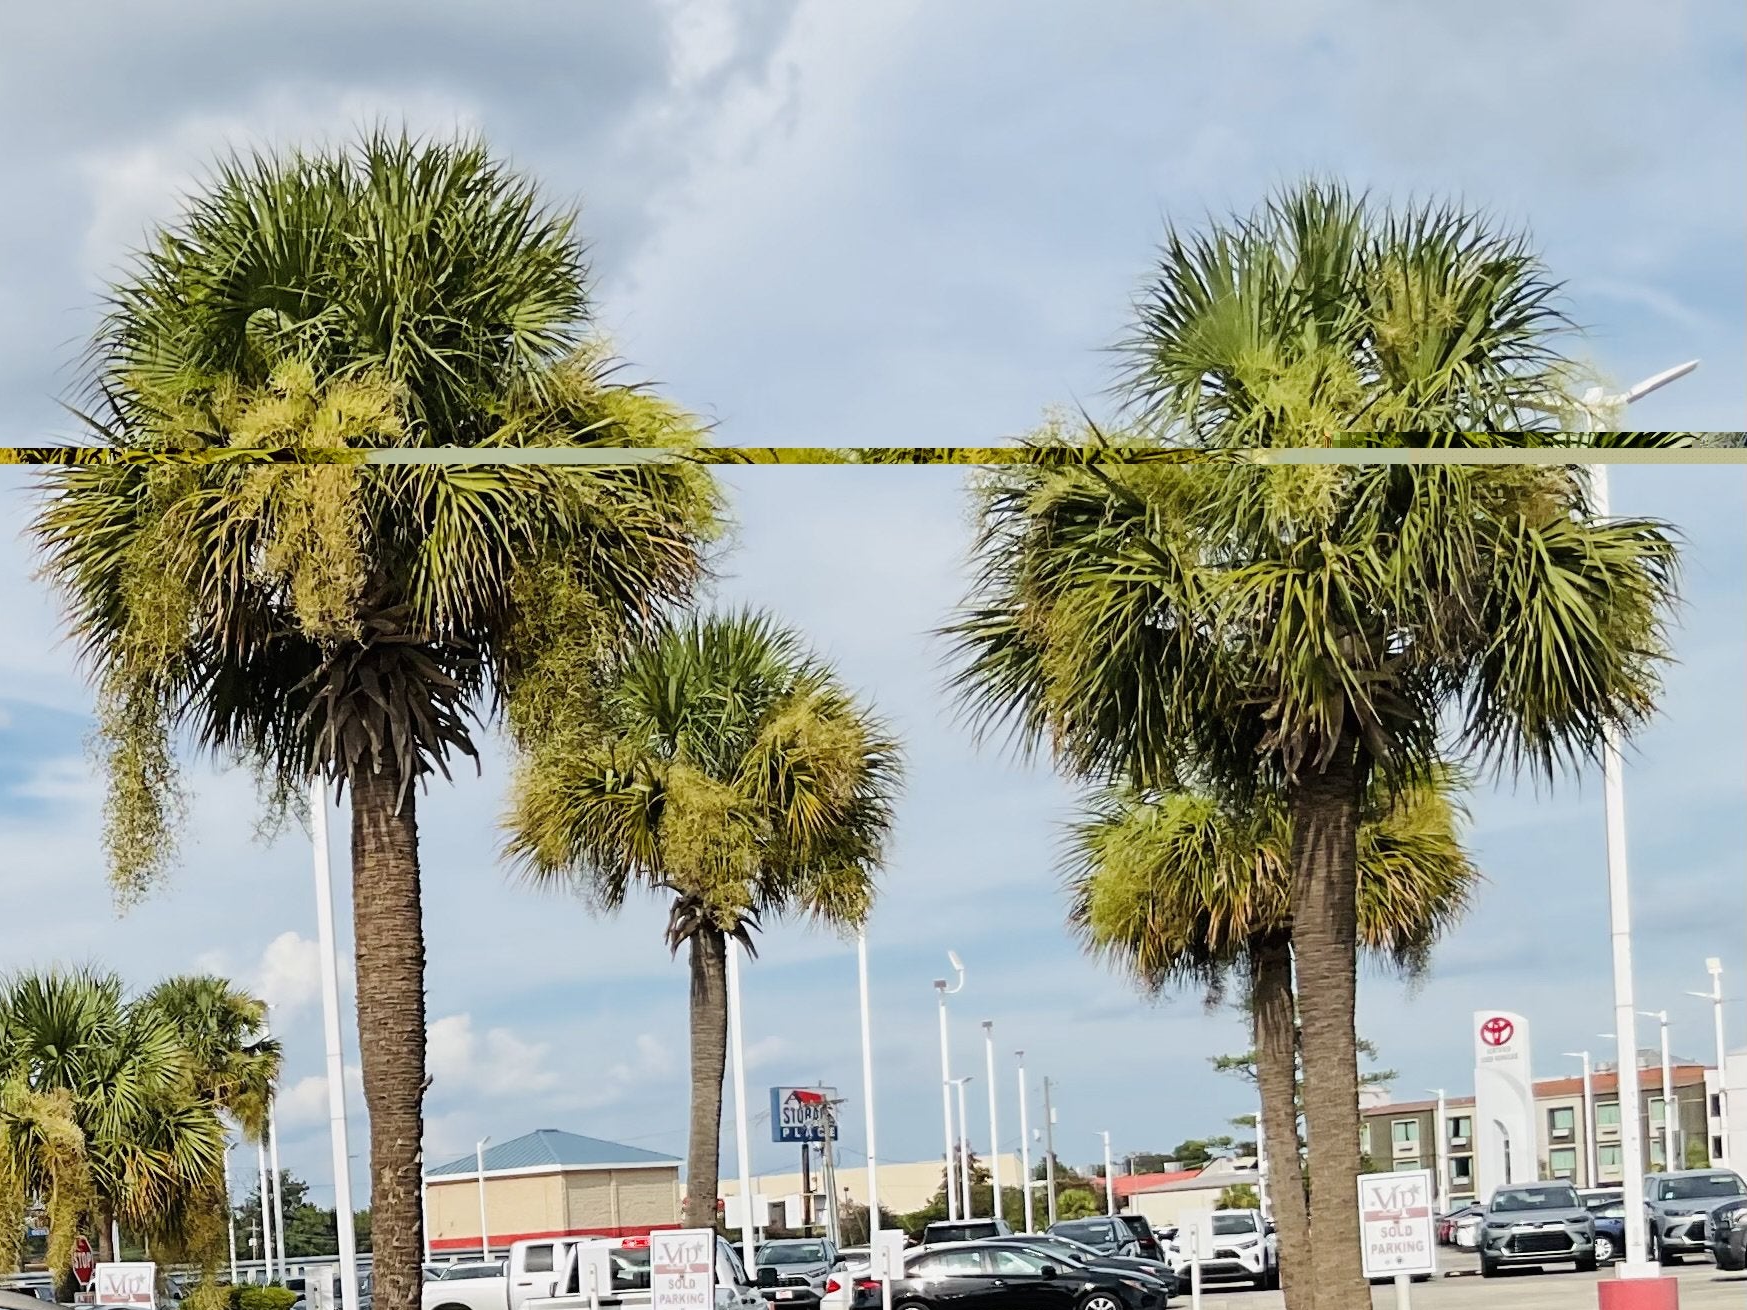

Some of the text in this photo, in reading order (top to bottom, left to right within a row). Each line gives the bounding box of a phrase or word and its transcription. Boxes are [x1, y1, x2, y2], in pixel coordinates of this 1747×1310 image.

[783, 1107, 836, 1124] STORA
[1380, 1225, 1412, 1239] SOLD
[1371, 1240, 1424, 1255] PARKING
[73, 1251, 92, 1269] STOP
[668, 1279, 695, 1290] SOLD
[659, 1293, 704, 1304] PARKING
